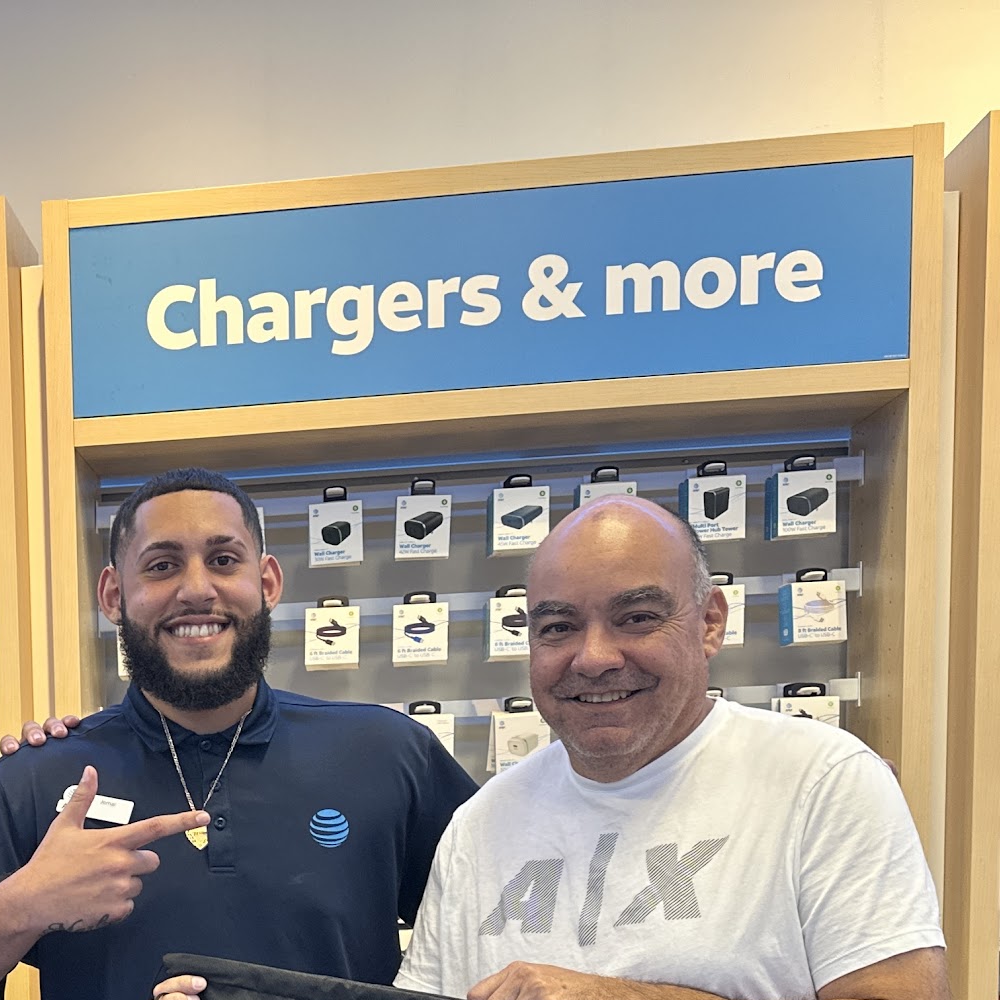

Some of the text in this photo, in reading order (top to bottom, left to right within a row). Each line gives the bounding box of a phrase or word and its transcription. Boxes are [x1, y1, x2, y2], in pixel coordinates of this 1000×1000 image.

[147, 249, 824, 356] Chargers & more
